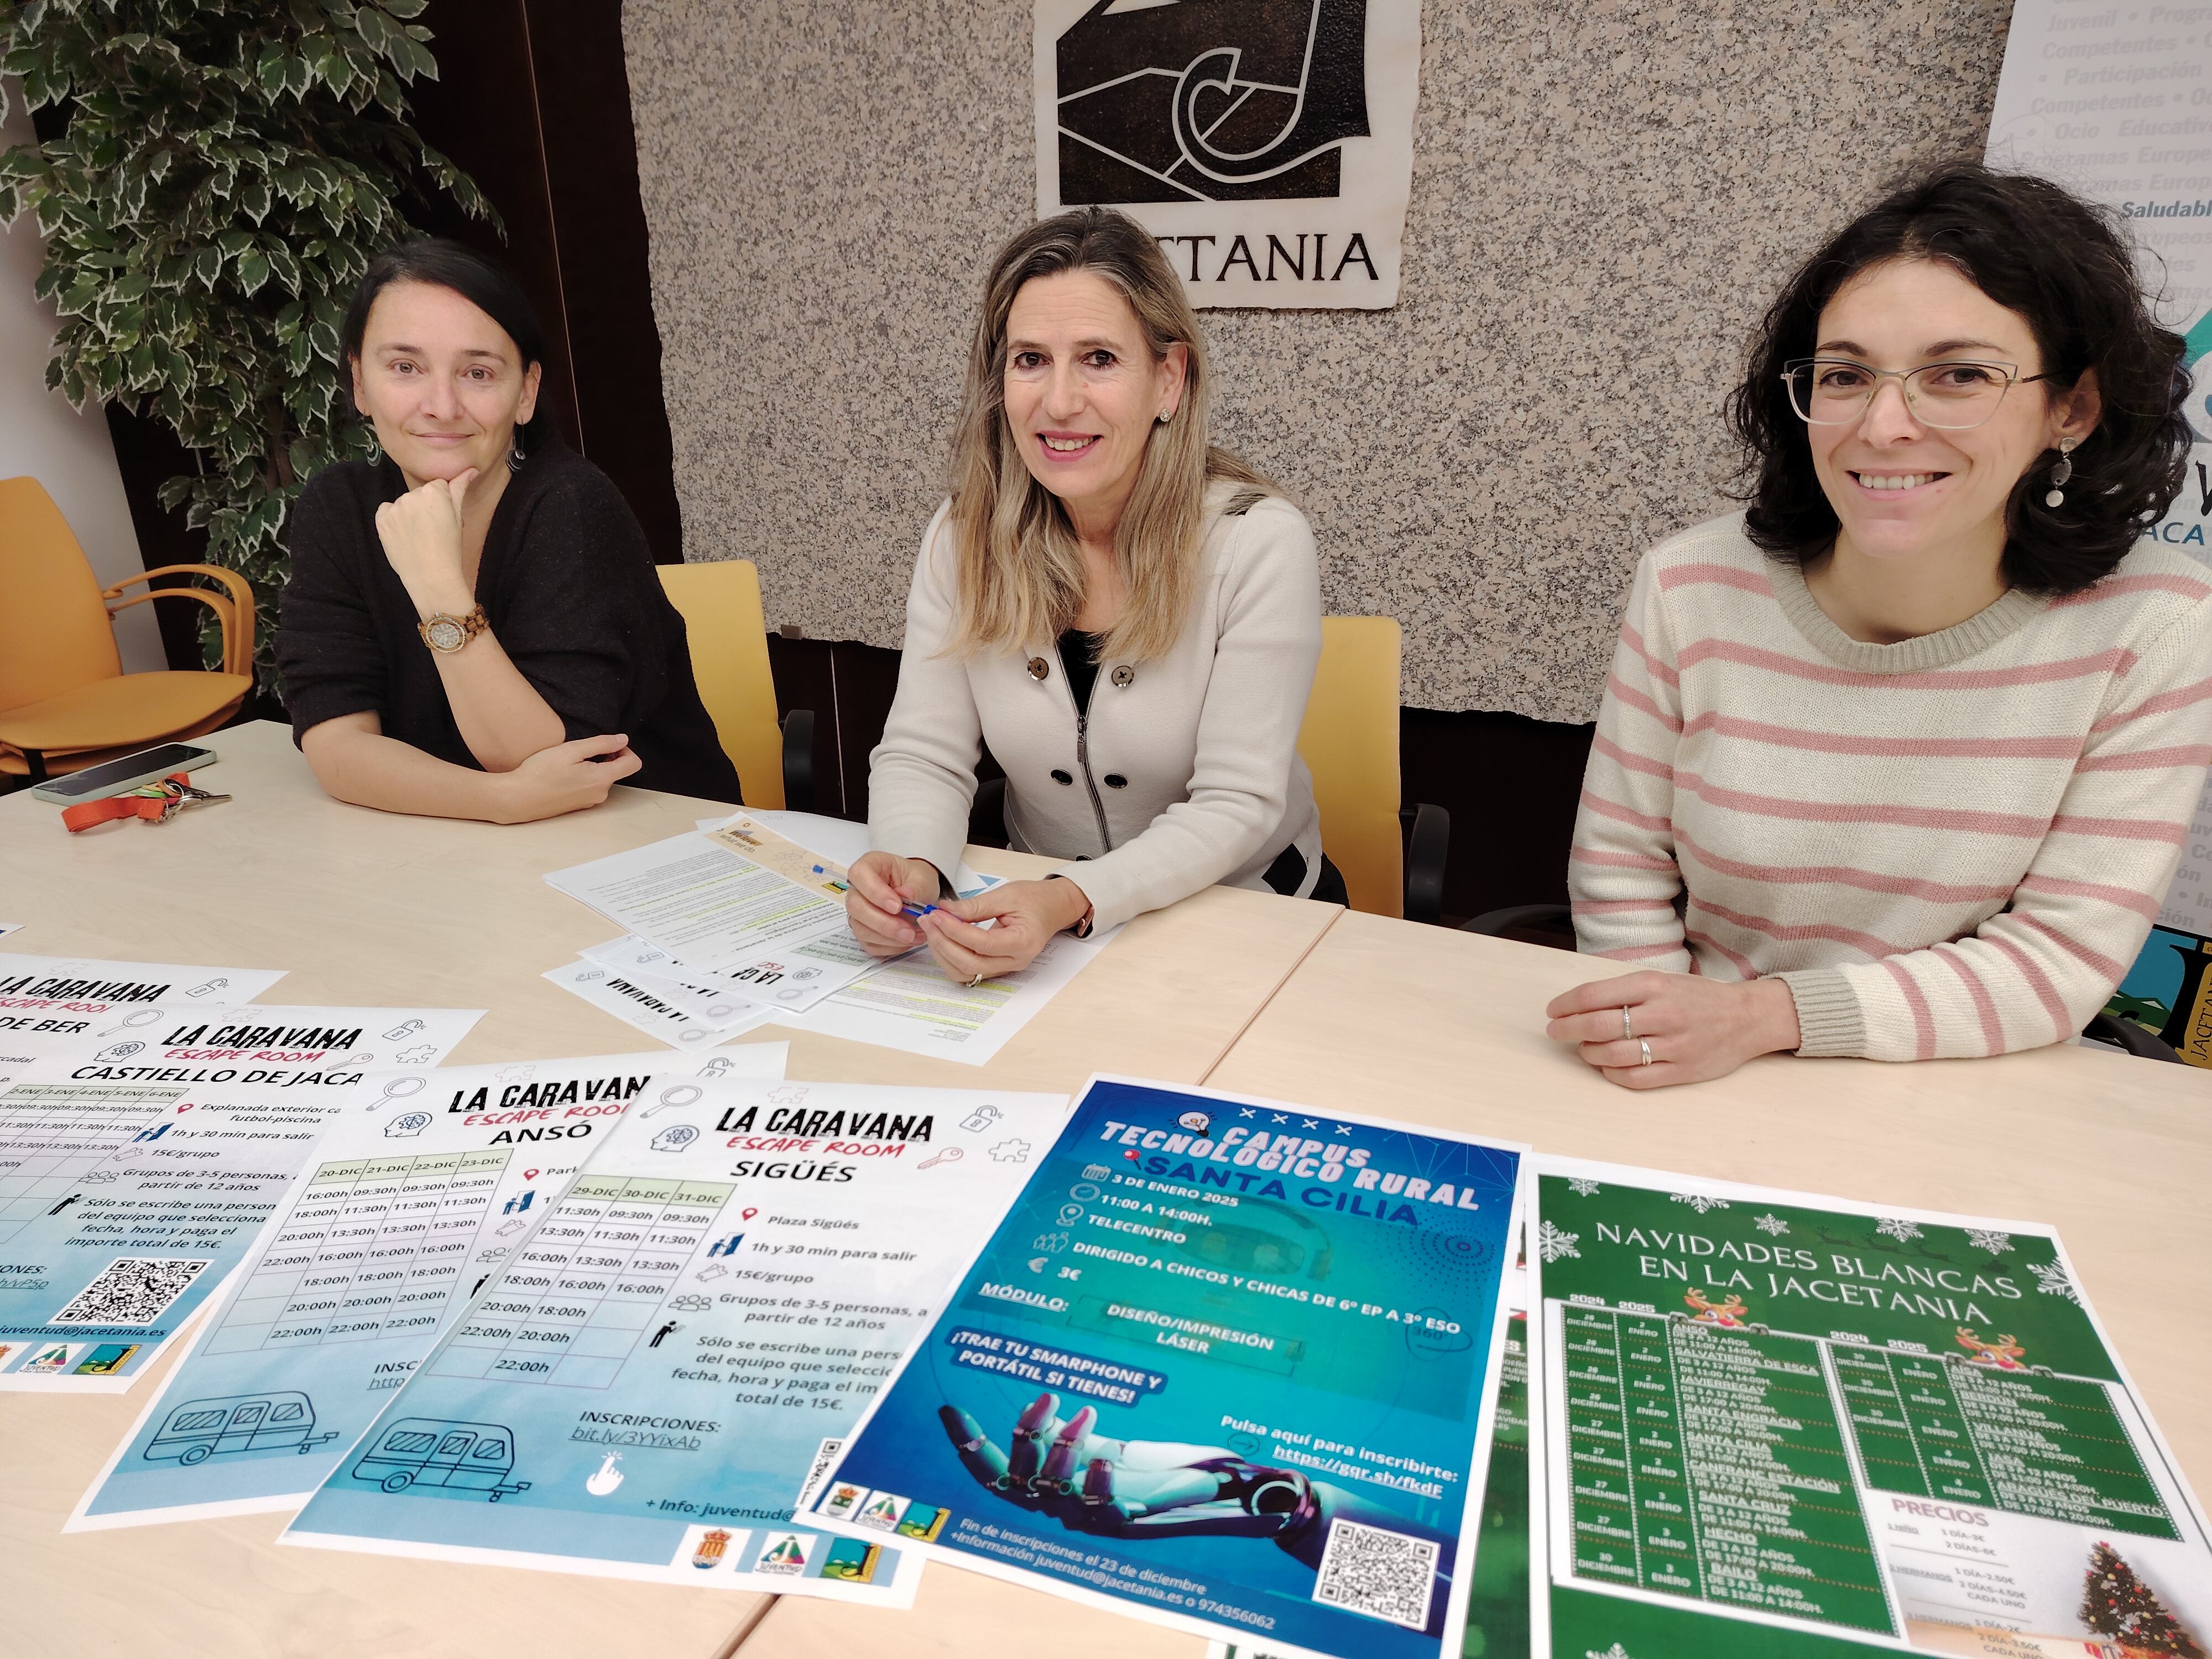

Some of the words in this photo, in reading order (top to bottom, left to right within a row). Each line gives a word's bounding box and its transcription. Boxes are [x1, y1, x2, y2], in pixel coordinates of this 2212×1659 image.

[2046, 9, 2117, 32] Juvenil
[2148, 6, 2212, 25] Progra
[2042, 34, 2178, 60] Competentes
[2063, 60, 2203, 86] Participación
[2031, 91, 2164, 115] Competentes
[2055, 122, 2100, 140] Ocio
[2136, 145, 2212, 165] Europe
[2122, 200, 2212, 218] Saludabl
[1155, 232, 1379, 281] TANIA
[2143, 521, 2205, 546] ACA
[757, 961, 785, 971] ESC
[25, 978, 171, 1003] CARAVANA
[0, 997, 62, 1009] SCAPE
[0, 1017, 35, 1030] DE
[30, 1019, 91, 1033] BER
[160, 1025, 209, 1045] LA
[206, 1025, 363, 1050] CARAVANA
[164, 1048, 251, 1060] ESCAPE
[248, 1051, 325, 1062] ROOM
[71, 1066, 237, 1082] CASTIELLO
[241, 1071, 288, 1083] DE
[280, 1072, 363, 1087] JACA
[448, 1087, 488, 1113] LA
[499, 1076, 650, 1108] CARAVAN
[229, 1114, 321, 1123] futbol-piscina
[463, 1108, 558, 1125] ESCAPE
[716, 1107, 758, 1132] LA
[765, 1108, 933, 1141] CARAVANA
[488, 1120, 591, 1144] ANSÓ
[727, 1136, 820, 1151] ESCAPE
[823, 1141, 905, 1157] ROOM
[1222, 1126, 1371, 1168] CAMPUS
[319, 1168, 362, 1177] 20-DIC
[414, 1161, 456, 1170] 22-DIC
[461, 1158, 503, 1166] 23-DIC
[730, 1160, 856, 1181] SIGÜÉS
[306, 1191, 347, 1199] 16:00h
[571, 1187, 618, 1196] 29-DIC
[622, 1190, 669, 1198] 30-DIC
[674, 1193, 721, 1202] 31-DIC
[1112, 1175, 1122, 1183] 3
[1124, 1177, 1145, 1188] DE
[1147, 1181, 1199, 1198] ENERO
[1202, 1192, 1238, 1207] 2025
[1144, 1156, 1287, 1201] SANTA
[1301, 1187, 1419, 1227] CILIA
[1353, 1168, 1480, 1211] RURAL
[1102, 1194, 1139, 1209] 11:00
[1141, 1203, 1152, 1213] A
[1159, 1206, 1211, 1225] 14:00H.
[768, 1216, 807, 1225] Plaza
[810, 1219, 859, 1229] Sigüés
[1089, 1214, 1186, 1243] TELECENTRO
[752, 1243, 769, 1251] 1h
[771, 1246, 782, 1255] y
[785, 1245, 804, 1253] 30
[807, 1247, 837, 1256] min
[841, 1250, 877, 1259] para
[881, 1251, 916, 1260] salir
[1596, 1222, 1818, 1270] NAVIDADES
[1830, 1255, 2021, 1298] BLANCAS
[736, 1270, 813, 1284] 15€/grupo
[1057, 1267, 1081, 1280] 3€
[979, 1282, 1068, 1312] MÓDULO:
[1073, 1242, 1147, 1266] DIRIGIDO
[1150, 1259, 1161, 1270] A
[1166, 1262, 1228, 1284] CHICOS
[1233, 1276, 1244, 1287] Y
[1246, 1280, 1308, 1301] CHICAS
[1312, 1293, 1335, 1307] DE
[1339, 1300, 1357, 1310] 6º
[1361, 1303, 1383, 1316] EP
[1385, 1310, 1399, 1321] A
[1403, 1313, 1422, 1323] 3º
[1426, 1317, 1460, 1333] ESO
[1639, 1255, 1687, 1281] EN
[1703, 1265, 1753, 1290] LA
[1767, 1273, 1992, 1324] JACETANIA
[1570, 1294, 1604, 1305] 2024
[1619, 1301, 1654, 1312] 2025
[1107, 1305, 1274, 1350] DISEÑO/IMPRESIÓN
[1156, 1332, 1209, 1353] LÁSER
[374, 1361, 418, 1373] INSC
[951, 1332, 1002, 1350] ¡TRAE
[1005, 1341, 1029, 1356] TU
[1029, 1348, 1145, 1385] SMARPHONE
[1149, 1376, 1162, 1389] Y
[1674, 1347, 1763, 1368] SALVATIERRA
[1764, 1359, 1782, 1370] DE
[1783, 1362, 1819, 1376] ESCA
[959, 1350, 1041, 1380] PORTÁTIL
[1045, 1371, 1065, 1385] SI
[1068, 1375, 1135, 1403] TIENES!
[579, 1411, 721, 1432] INSCRIPCIONES:
[1220, 1415, 1267, 1435] Pulsa
[1271, 1429, 1312, 1445] aquí
[1313, 1438, 1354, 1456] para
[1359, 1447, 1458, 1482] inscribirte:
[659, 1499, 699, 1512] Info:
[698, 1503, 795, 1522] juventud@
[1698, 1490, 1748, 1509] SANTA
[1750, 1499, 1792, 1516] CRUZ
[1891, 1498, 1989, 1526] PRECIOS
[1705, 1526, 1757, 1544] HECHO
[959, 1518, 980, 1532] Fin
[981, 1525, 999, 1537] de
[999, 1528, 1084, 1561] inscripciones
[1084, 1554, 1100, 1566] el
[1098, 1557, 1118, 1571] 23
[1118, 1564, 1137, 1577] de
[1138, 1568, 1206, 1594] diciembre
[951, 1531, 1034, 1562] +Información
[1032, 1553, 1183, 1604] juventud@jacetania.es
[1185, 1597, 1196, 1606] o
[1197, 1598, 1275, 1629] 974356062
[1711, 1563, 1757, 1580] BAILO
